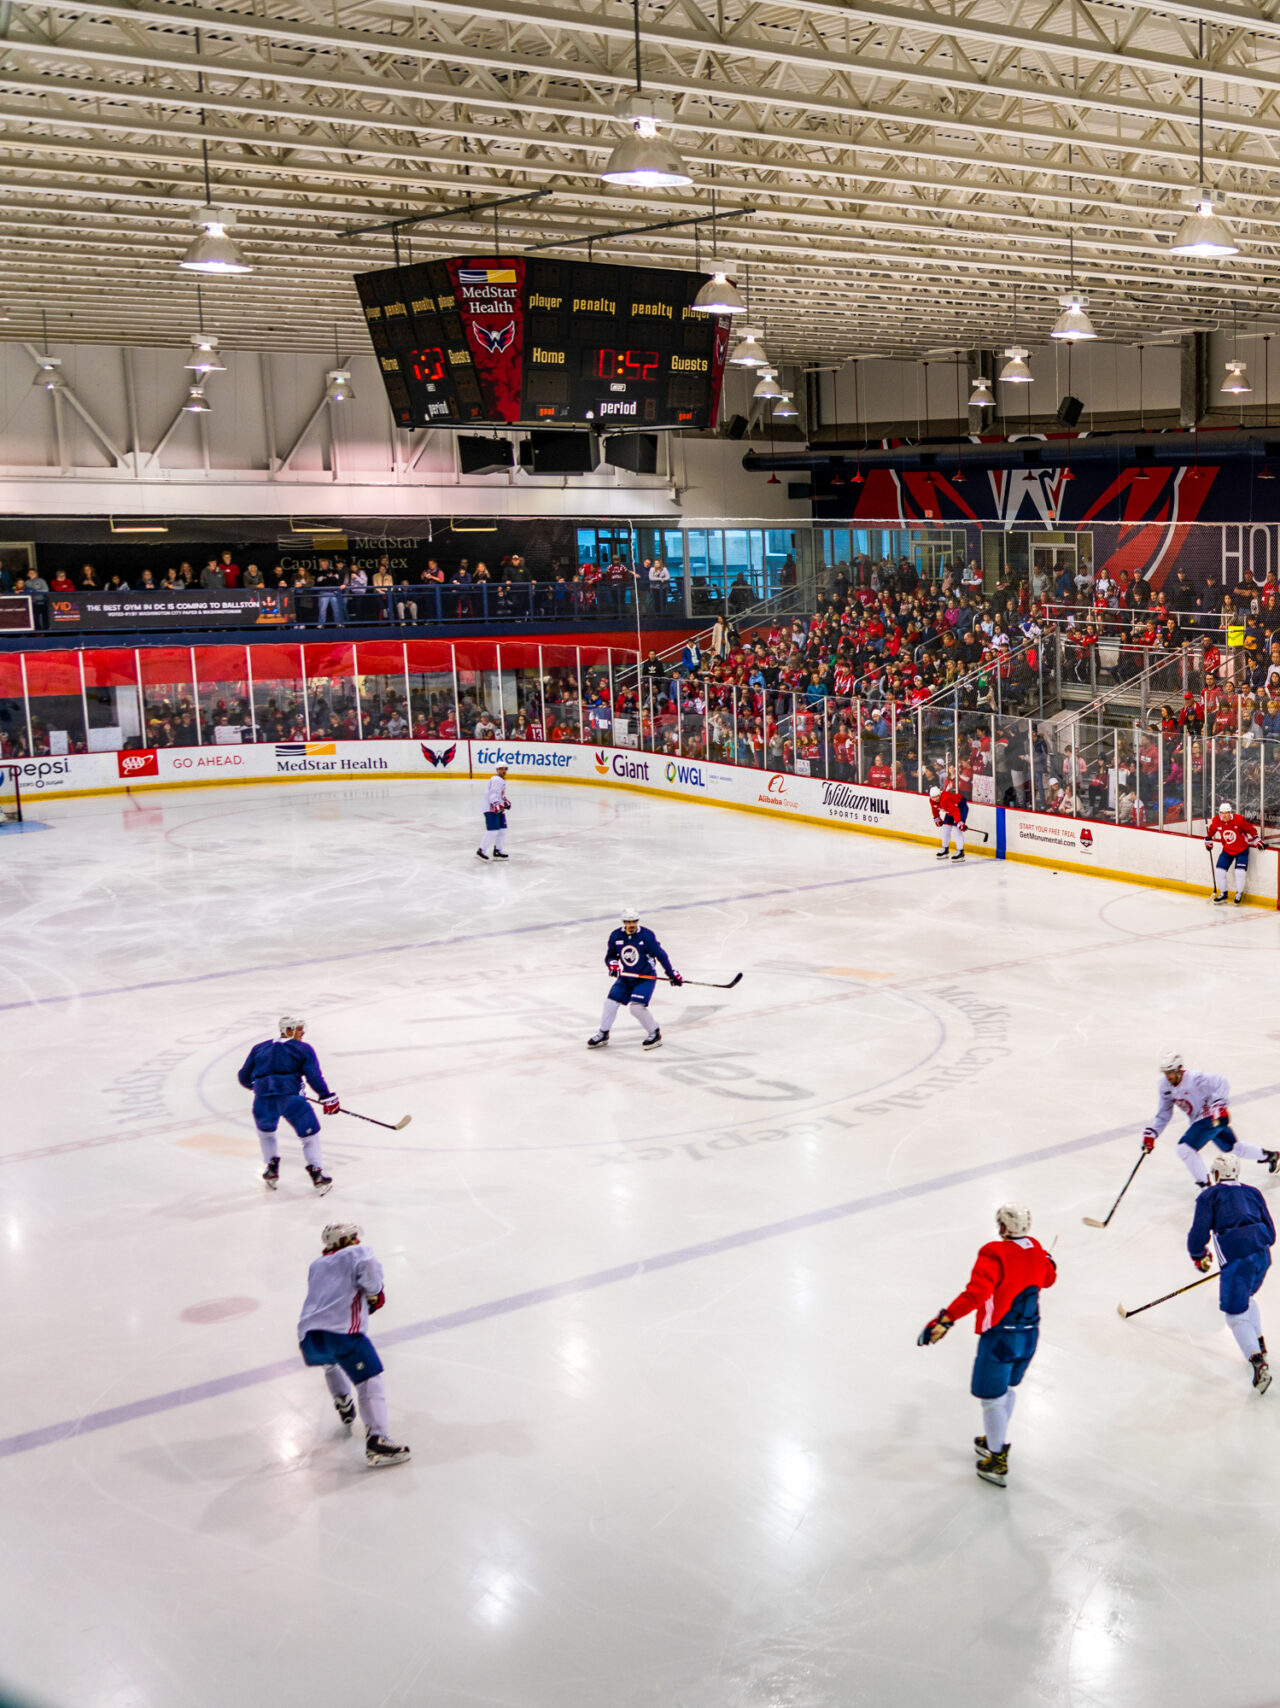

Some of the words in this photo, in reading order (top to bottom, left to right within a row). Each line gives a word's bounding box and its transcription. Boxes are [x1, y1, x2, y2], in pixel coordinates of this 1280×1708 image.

[462, 286, 517, 298] MedStar
[469, 301, 514, 313] Health
[529, 293, 562, 310] player
[573, 298, 616, 315] penalty
[632, 302, 673, 319] penalty
[533, 347, 565, 364] Home
[671, 355, 708, 371] Guests
[601, 401, 637, 417] period
[355, 537, 420, 549] MedStar
[123, 603, 142, 611] GYM
[176, 602, 208, 610] COMING
[172, 758, 193, 768] GO
[197, 755, 245, 767] AHEAD.
[277, 760, 337, 771] MedStar
[341, 758, 388, 770] Health
[478, 748, 572, 767] ticketmaster
[8, 758, 69, 781] pepsi
[612, 754, 650, 781] Giant
[678, 765, 705, 787] WGL
[758, 794, 782, 805] Alibaba
[822, 781, 869, 811] William
[870, 798, 890, 814] HILL
[829, 809, 858, 820] SPORTS
[1020, 831, 1076, 847] GetMonumental.com
